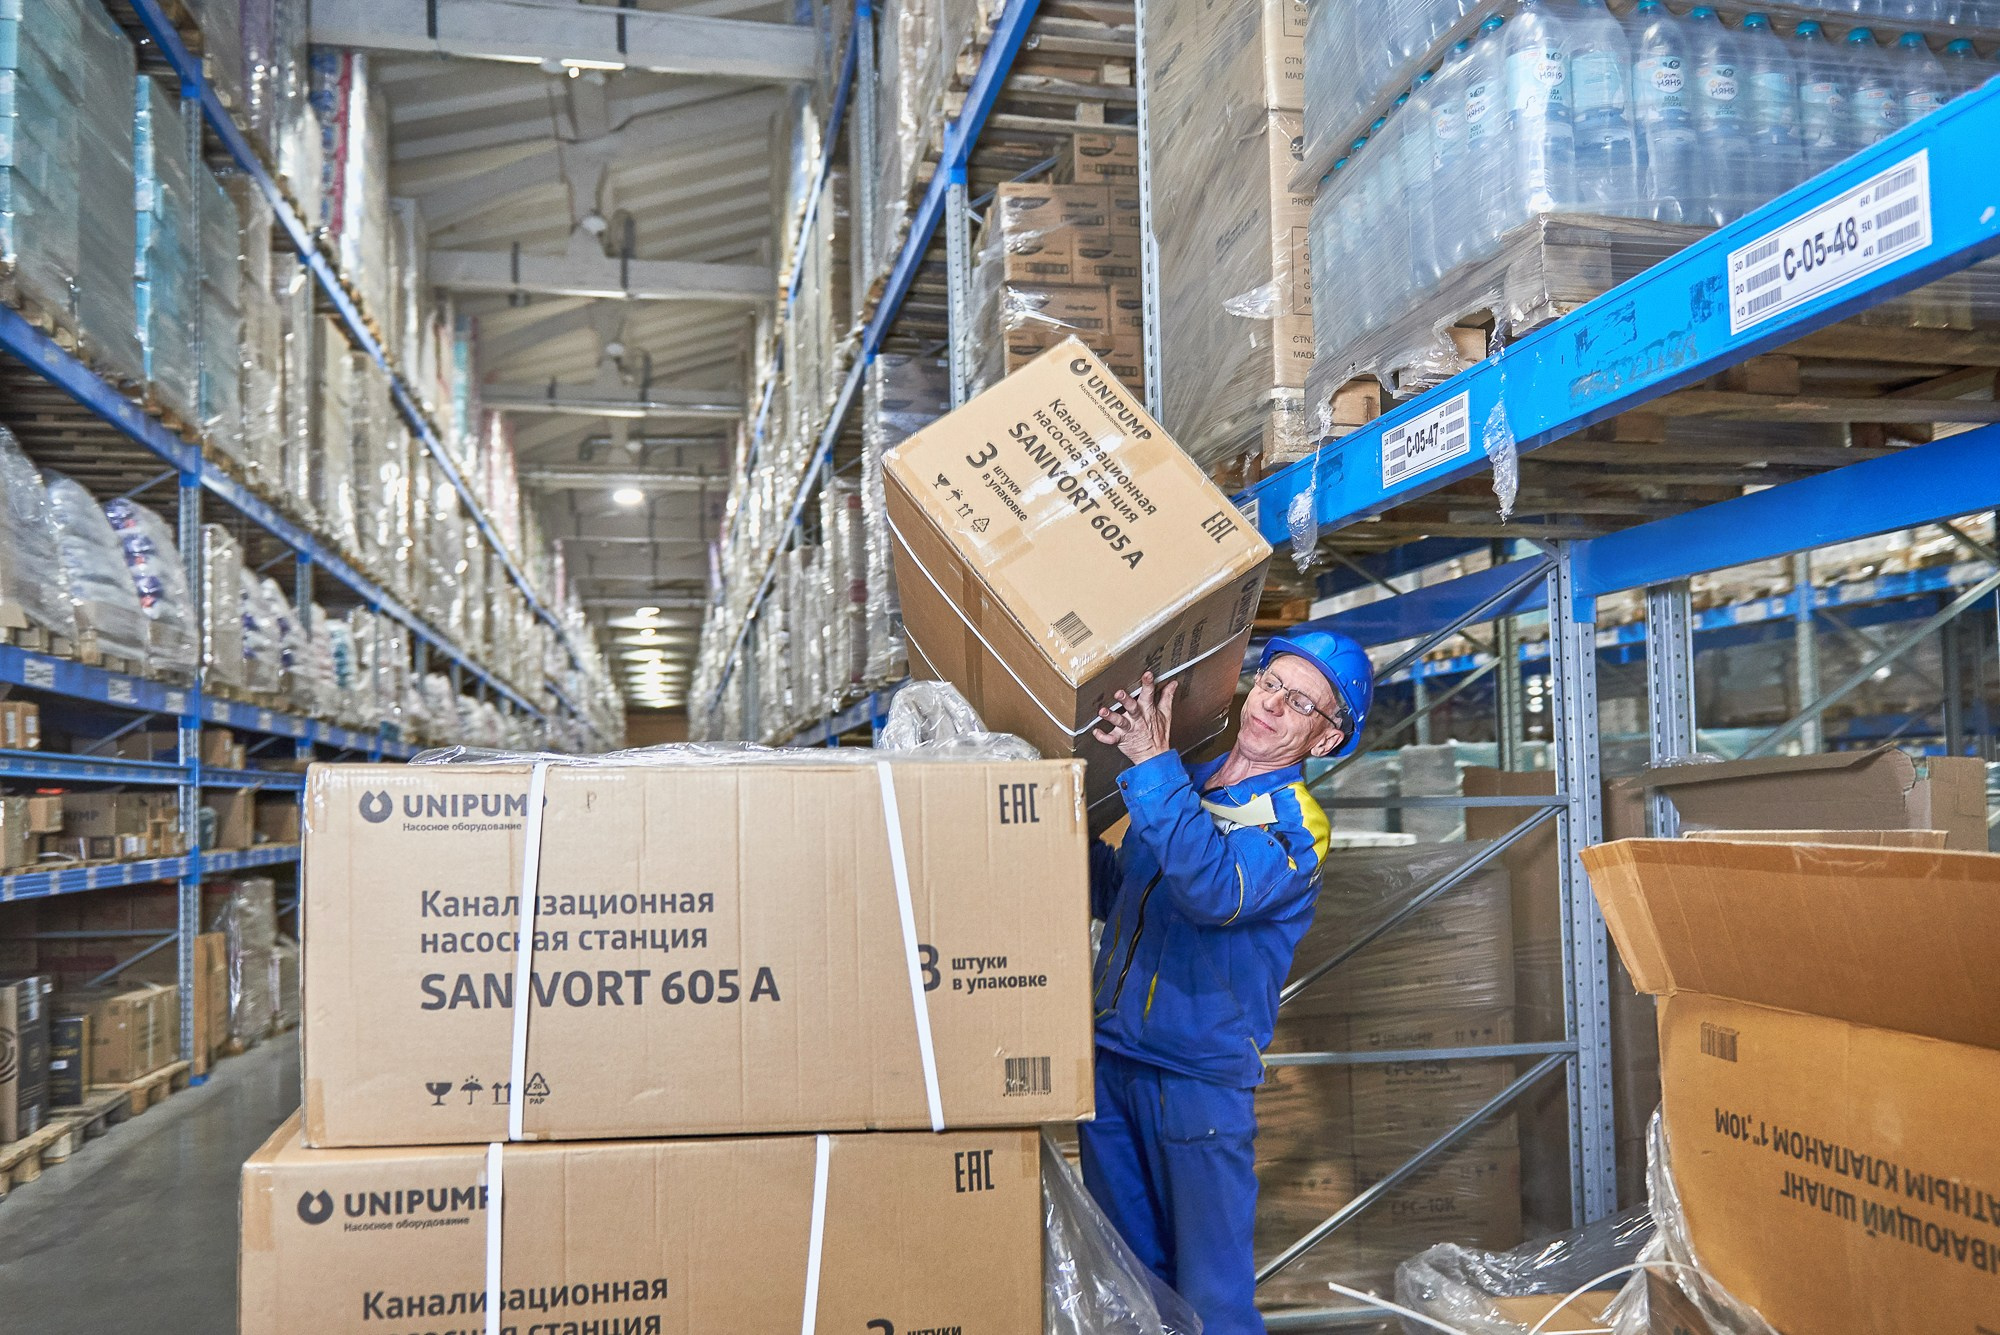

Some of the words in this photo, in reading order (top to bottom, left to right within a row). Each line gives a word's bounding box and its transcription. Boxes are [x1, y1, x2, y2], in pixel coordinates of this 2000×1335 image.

[1861, 219, 1873, 233] 50
[1734, 260, 1744, 273] 30
[1735, 283, 1745, 295] 20
[1736, 306, 1746, 317] 10
[1087, 375, 1152, 440] UNIPUMP
[966, 442, 998, 469] 3
[1032, 409, 1090, 469] насосная
[1086, 468, 1140, 524] станция
[1048, 398, 1158, 516] Канализационная
[982, 472, 991, 481] в
[993, 465, 1022, 496] штуки
[1008, 422, 1101, 515] SANIVORT
[1090, 514, 1132, 552] 605
[985, 479, 1028, 522] упаковке
[1200, 510, 1239, 544] EAC
[403, 793, 548, 818] UNIPUM
[999, 783, 1040, 824] EAC
[402, 822, 450, 832] Насосное
[451, 821, 522, 833] оборудование
[421, 889, 715, 920] Каналзационная
[579, 926, 709, 952] станция
[951, 956, 1008, 974] штуки
[421, 969, 651, 1011] SANVORT
[661, 968, 740, 1005] 605
[952, 978, 963, 991] в
[966, 974, 1048, 995] упаковке
[954, 1149, 995, 1194] EAC
[1773, 1125, 1898, 1192] КЛАПАНОМ
[1780, 1170, 1857, 1222] ШЛАНГ
[344, 1221, 393, 1232] Насосное
[395, 1216, 470, 1230] оборудование
